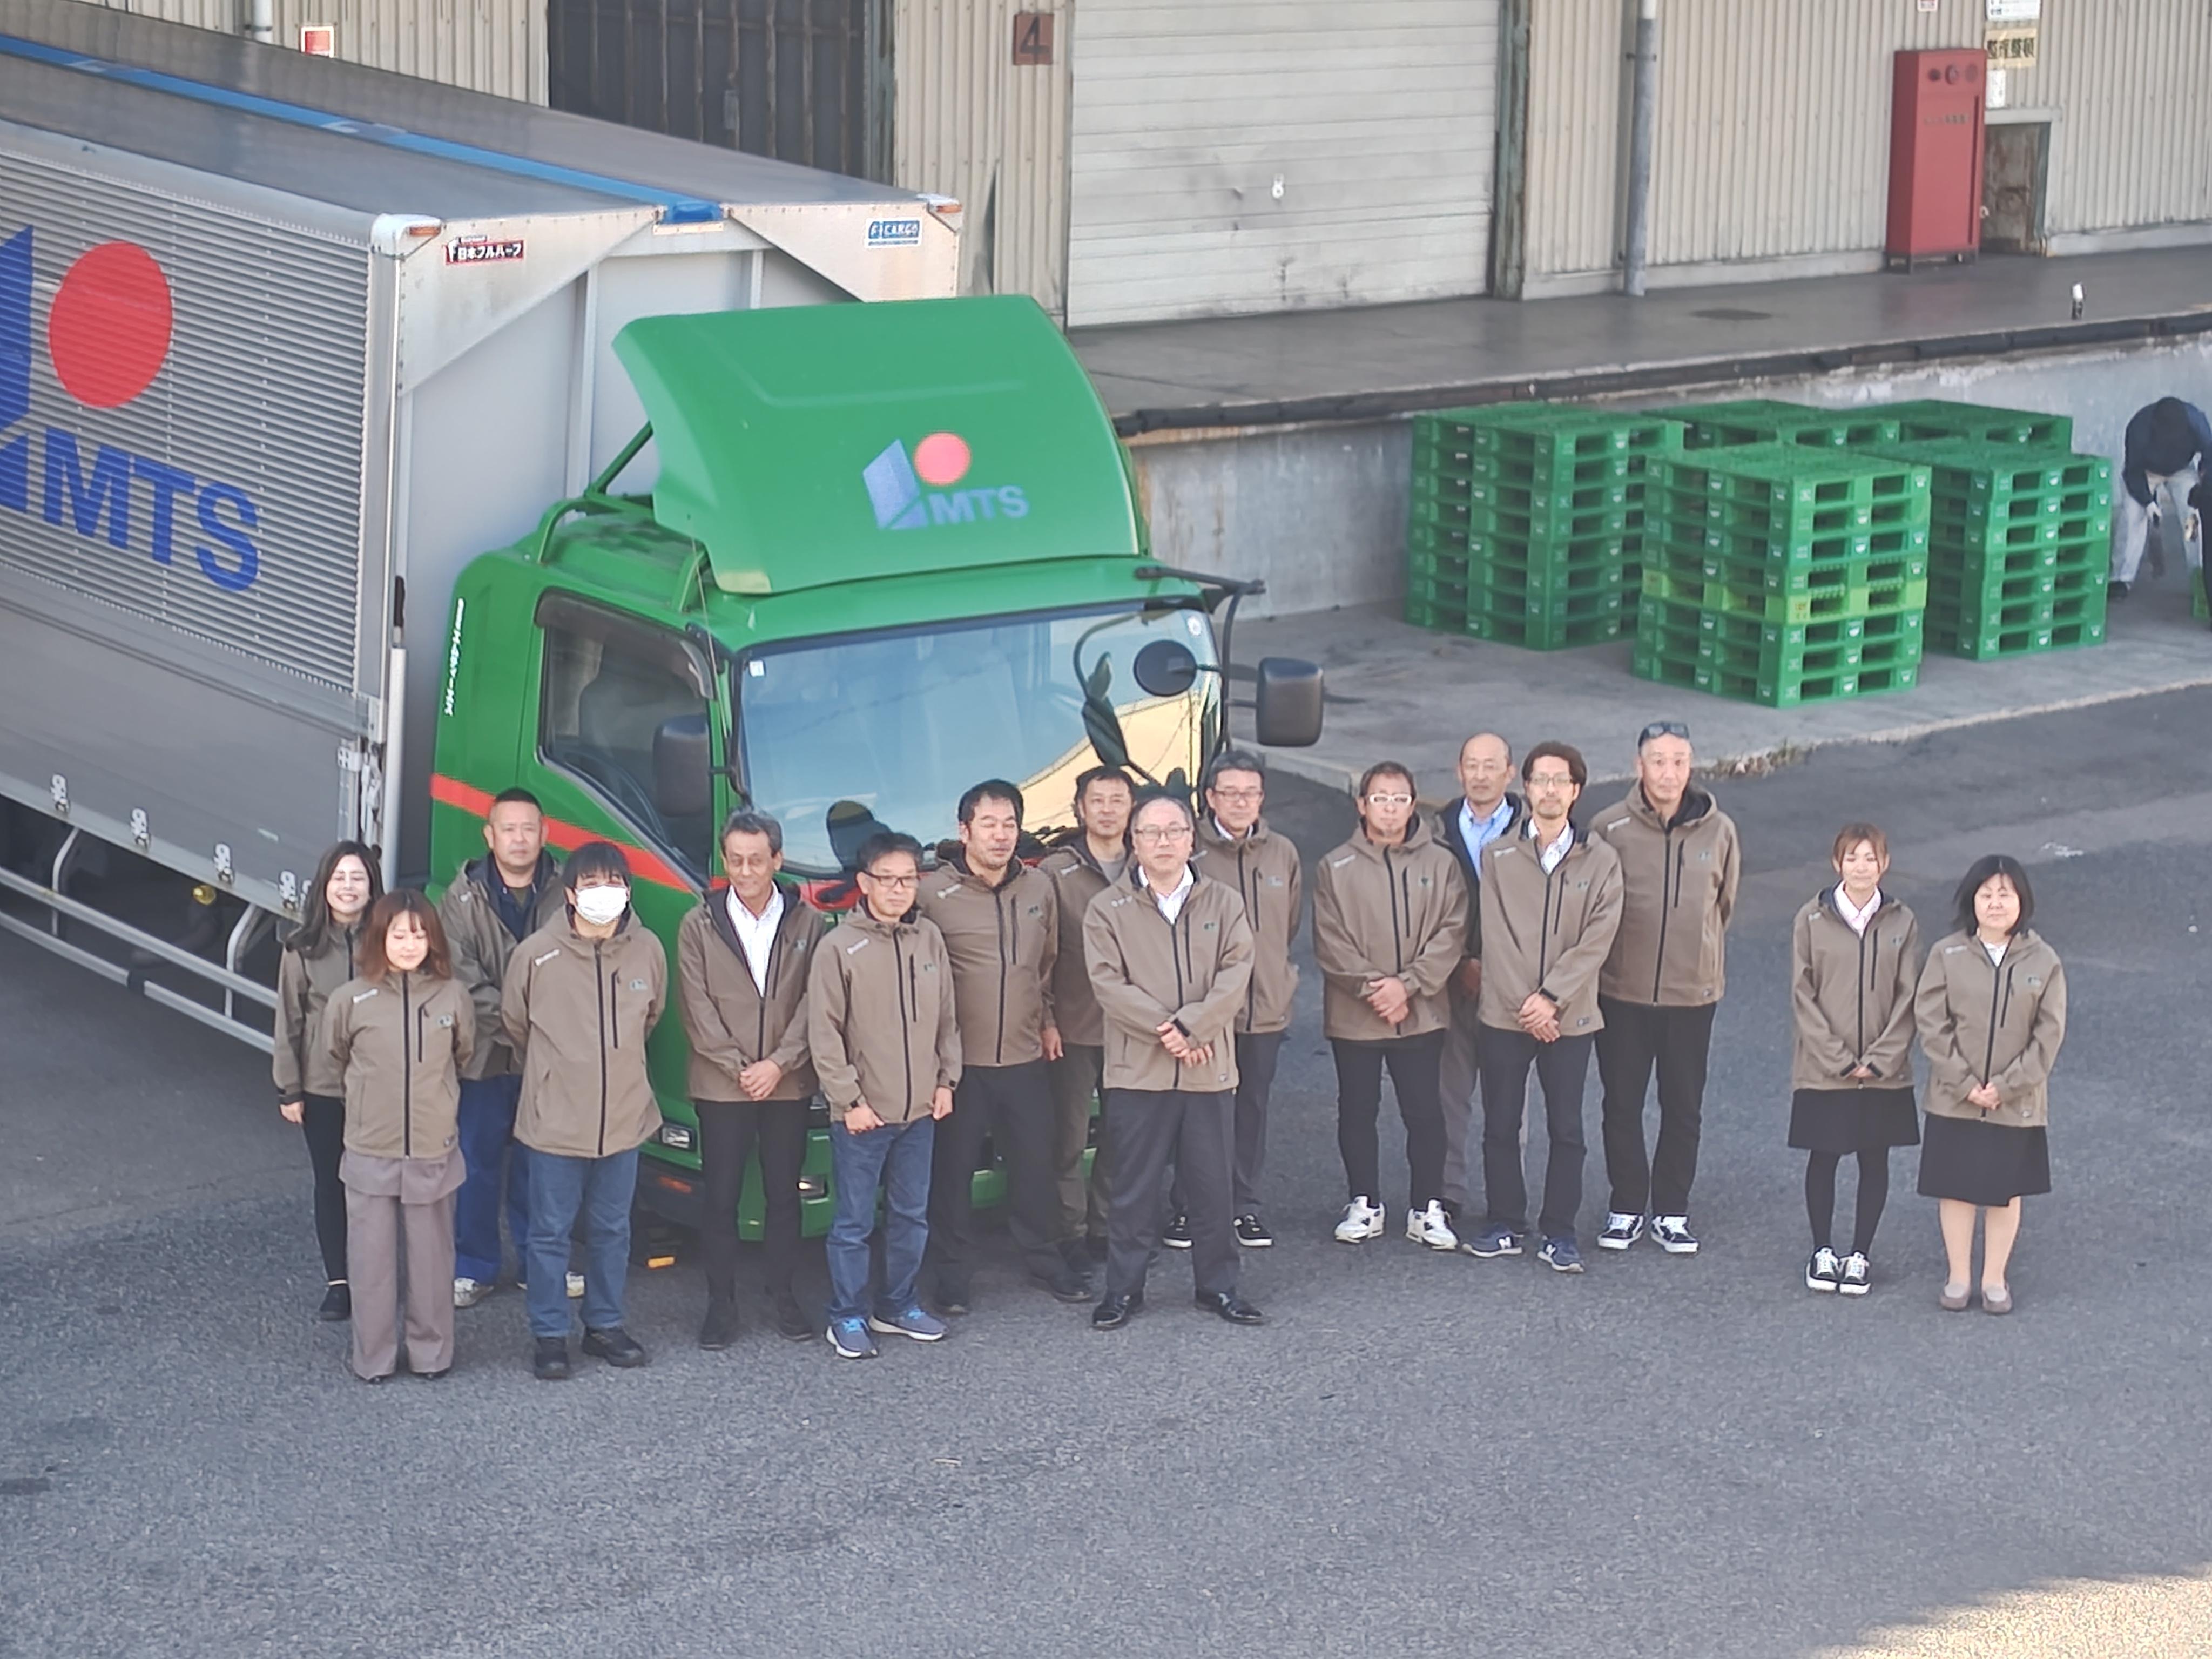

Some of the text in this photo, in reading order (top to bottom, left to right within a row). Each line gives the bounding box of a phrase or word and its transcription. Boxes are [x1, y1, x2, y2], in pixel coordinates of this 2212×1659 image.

[1019, 15, 1050, 64] 4
[457, 242, 521, 260] 日本フルハーフ
[43, 427, 259, 591] MTS
[928, 485, 1029, 524] MTS
